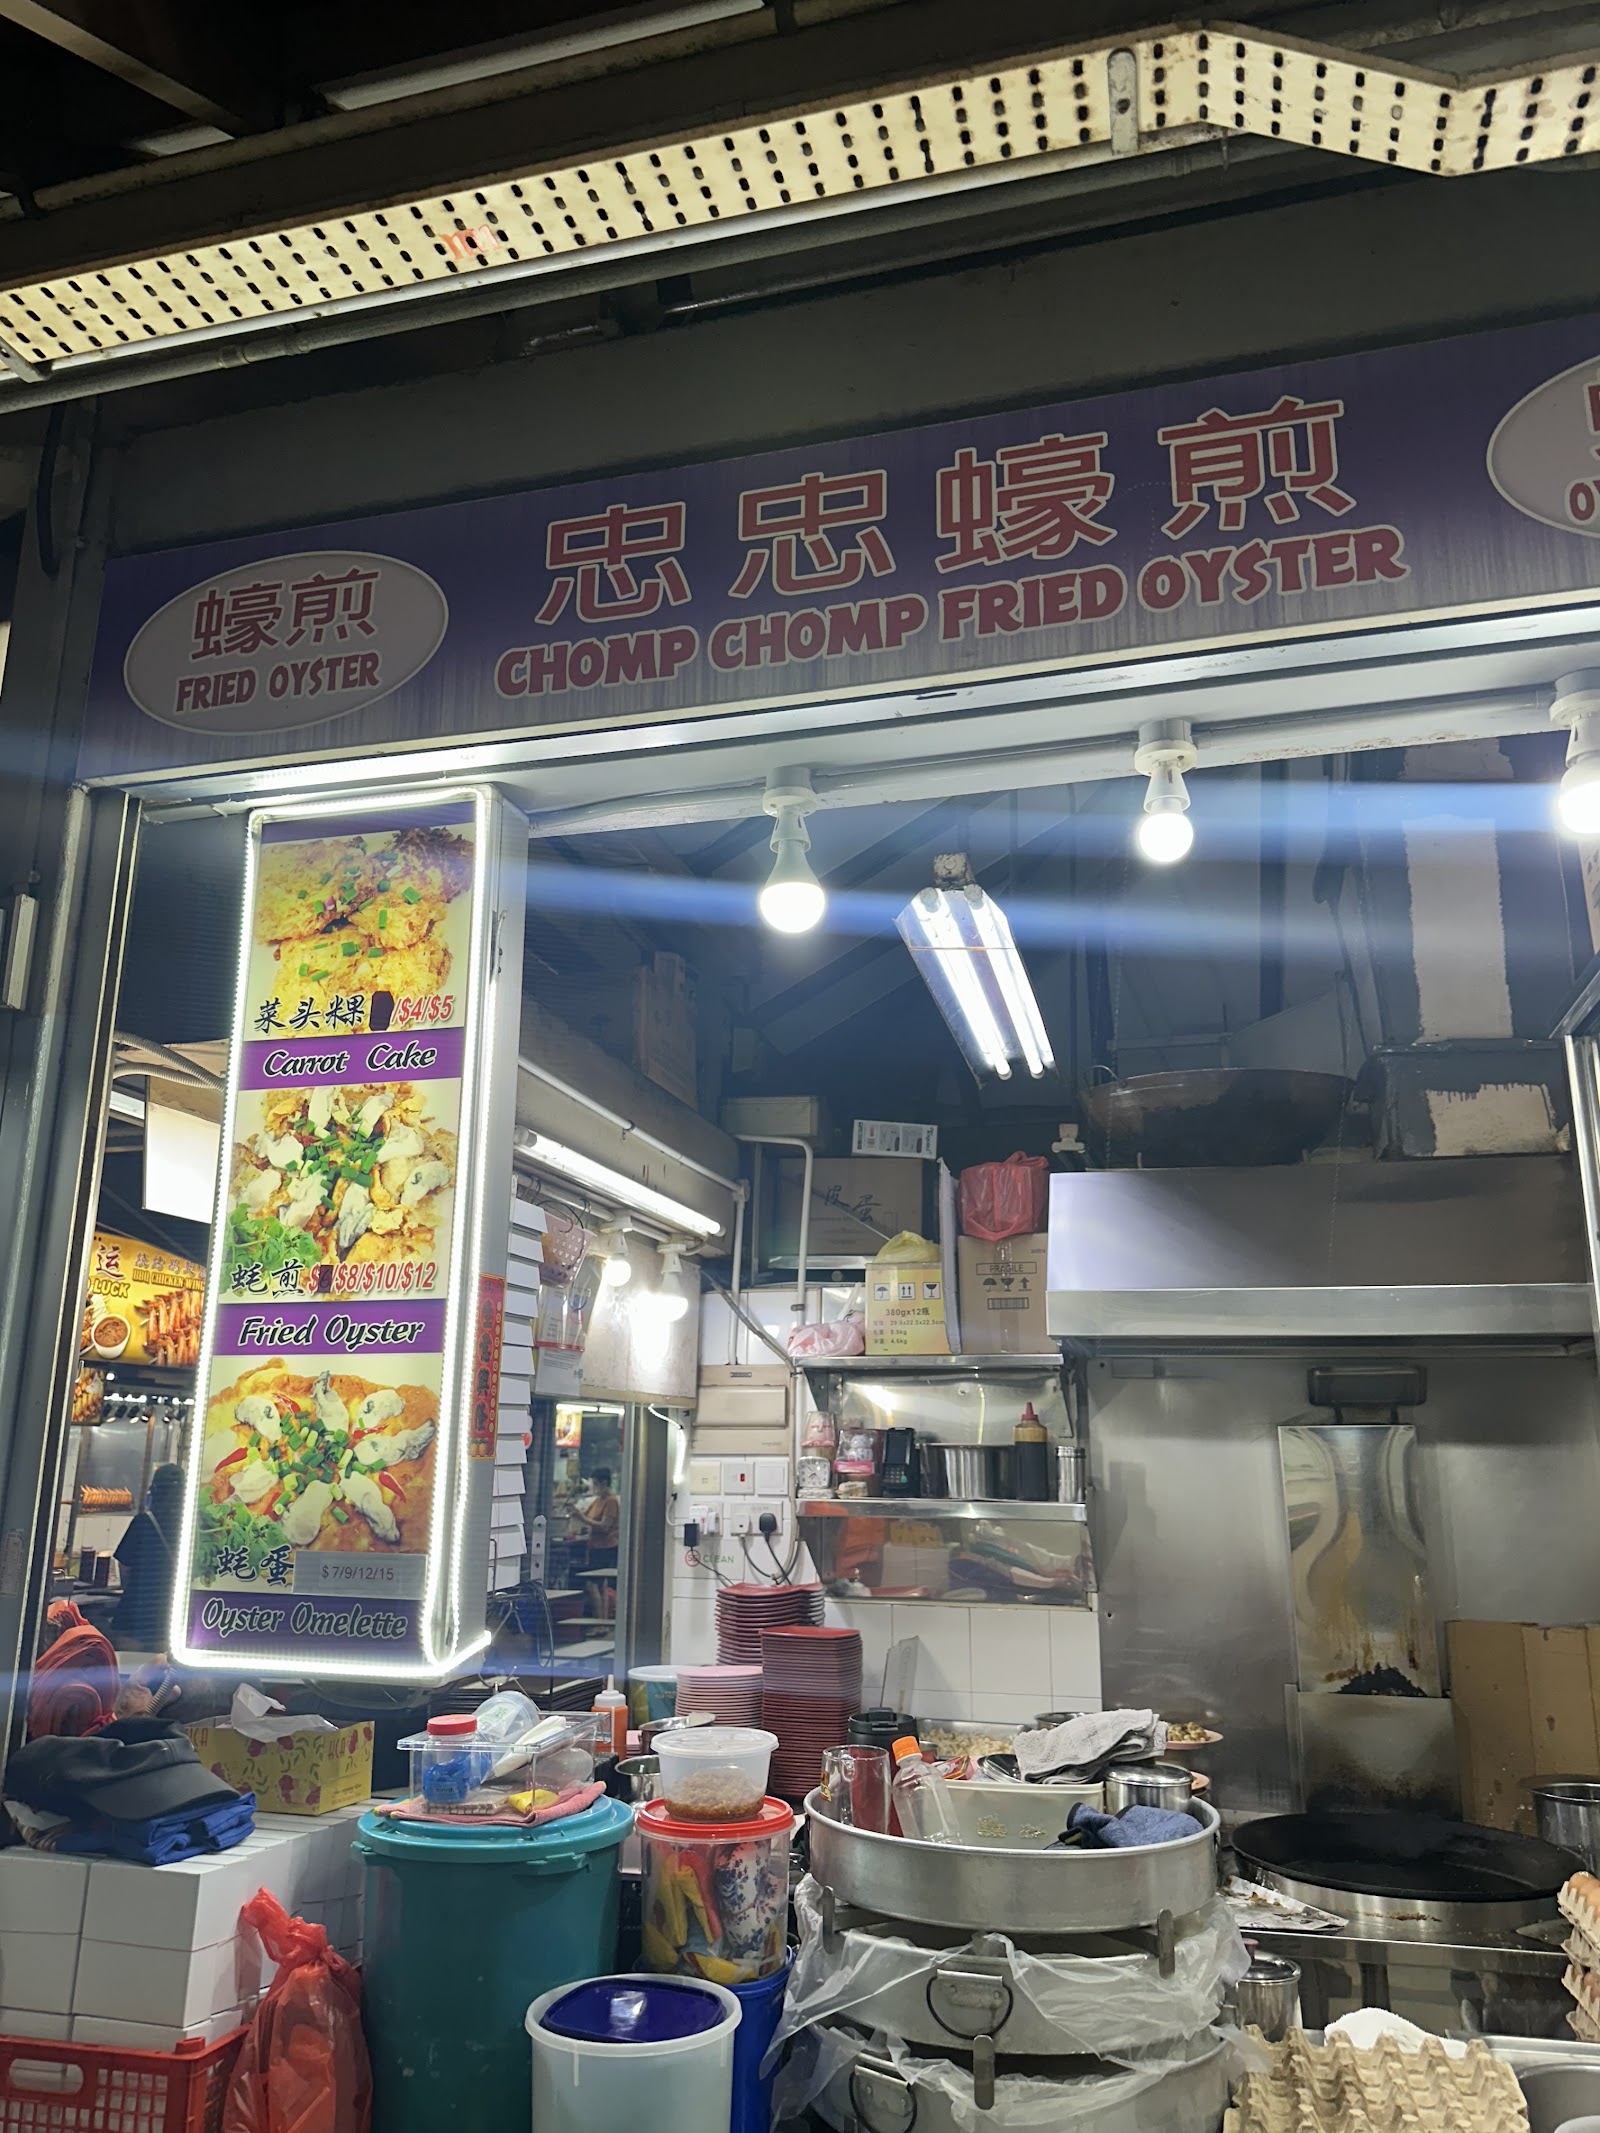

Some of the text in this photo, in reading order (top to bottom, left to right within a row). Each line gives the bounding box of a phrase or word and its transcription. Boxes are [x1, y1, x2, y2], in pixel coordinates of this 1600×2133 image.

[190, 568, 382, 662] 蠔煎
[497, 527, 1409, 696] CHOMP CHOMP FRIED OYSTER
[175, 653, 380, 712] FRIED OYSTER
[254, 994, 365, 1034] 菜头粿
[263, 1040, 438, 1077] Carrot Cake
[93, 1279, 129, 1298] LUCK
[132, 1268, 151, 1284] BBQ
[151, 1270, 185, 1289] CHICKEN
[231, 1258, 305, 1299] 蚝煎
[990, 1264, 1024, 1273] FRAGILE
[238, 1314, 425, 1352] Fried Oyster
[216, 1543, 293, 1587] 蚝蛋
[202, 1597, 408, 1639] Oyster Omelette
